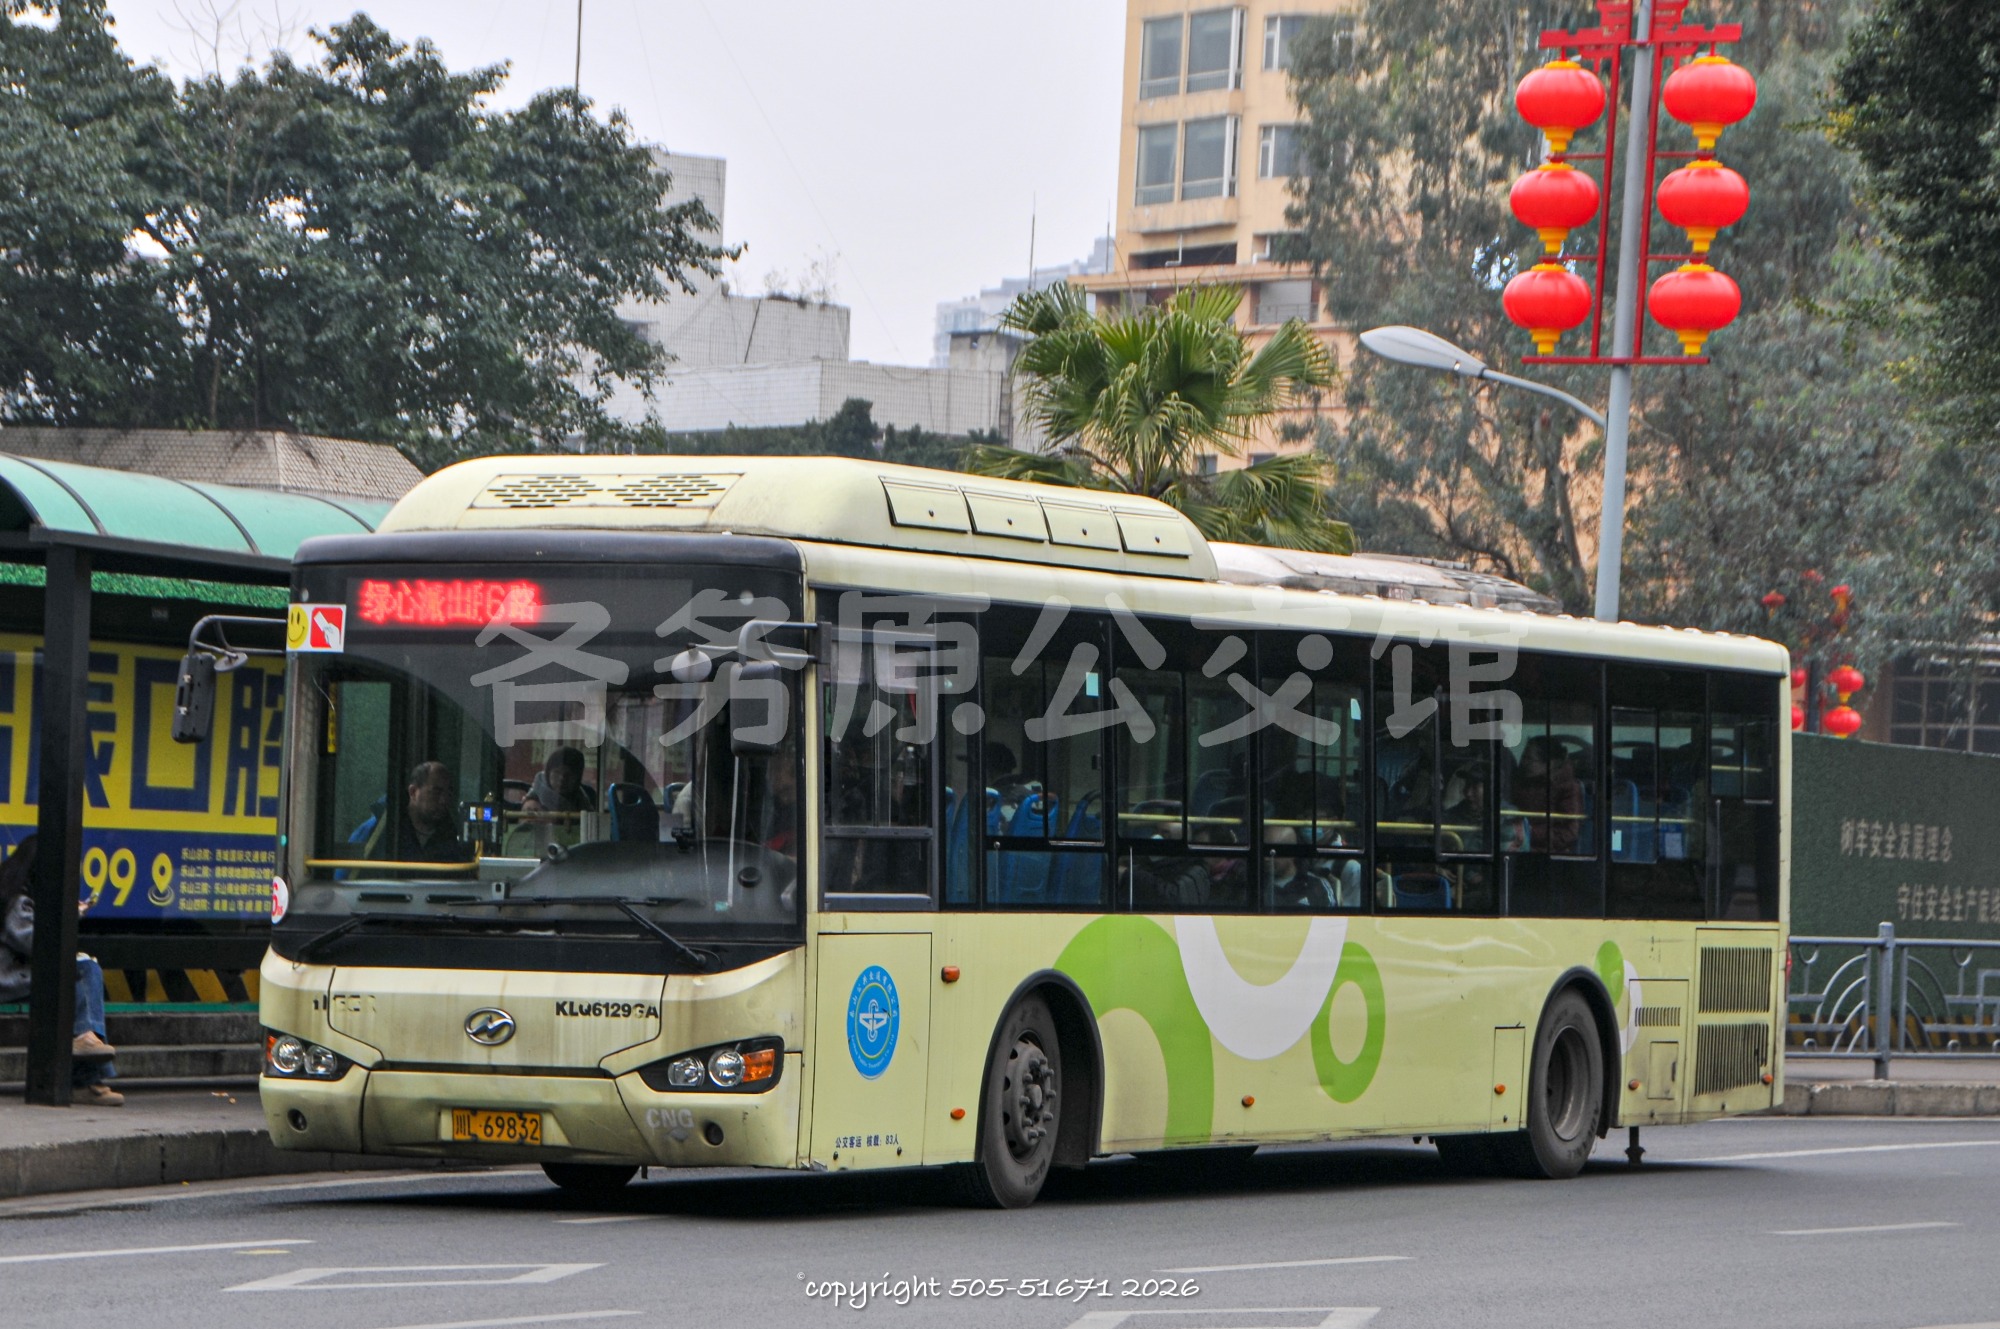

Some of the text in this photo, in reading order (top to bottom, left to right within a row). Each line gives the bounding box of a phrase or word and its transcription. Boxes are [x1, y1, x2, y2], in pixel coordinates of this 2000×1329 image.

[1840, 818, 1953, 863] 树牢安全发展理念
[555, 1000, 659, 1019] KLQ6129GA
[645, 1107, 695, 1129] CNG
[835, 1136, 862, 1149] 公交客运
